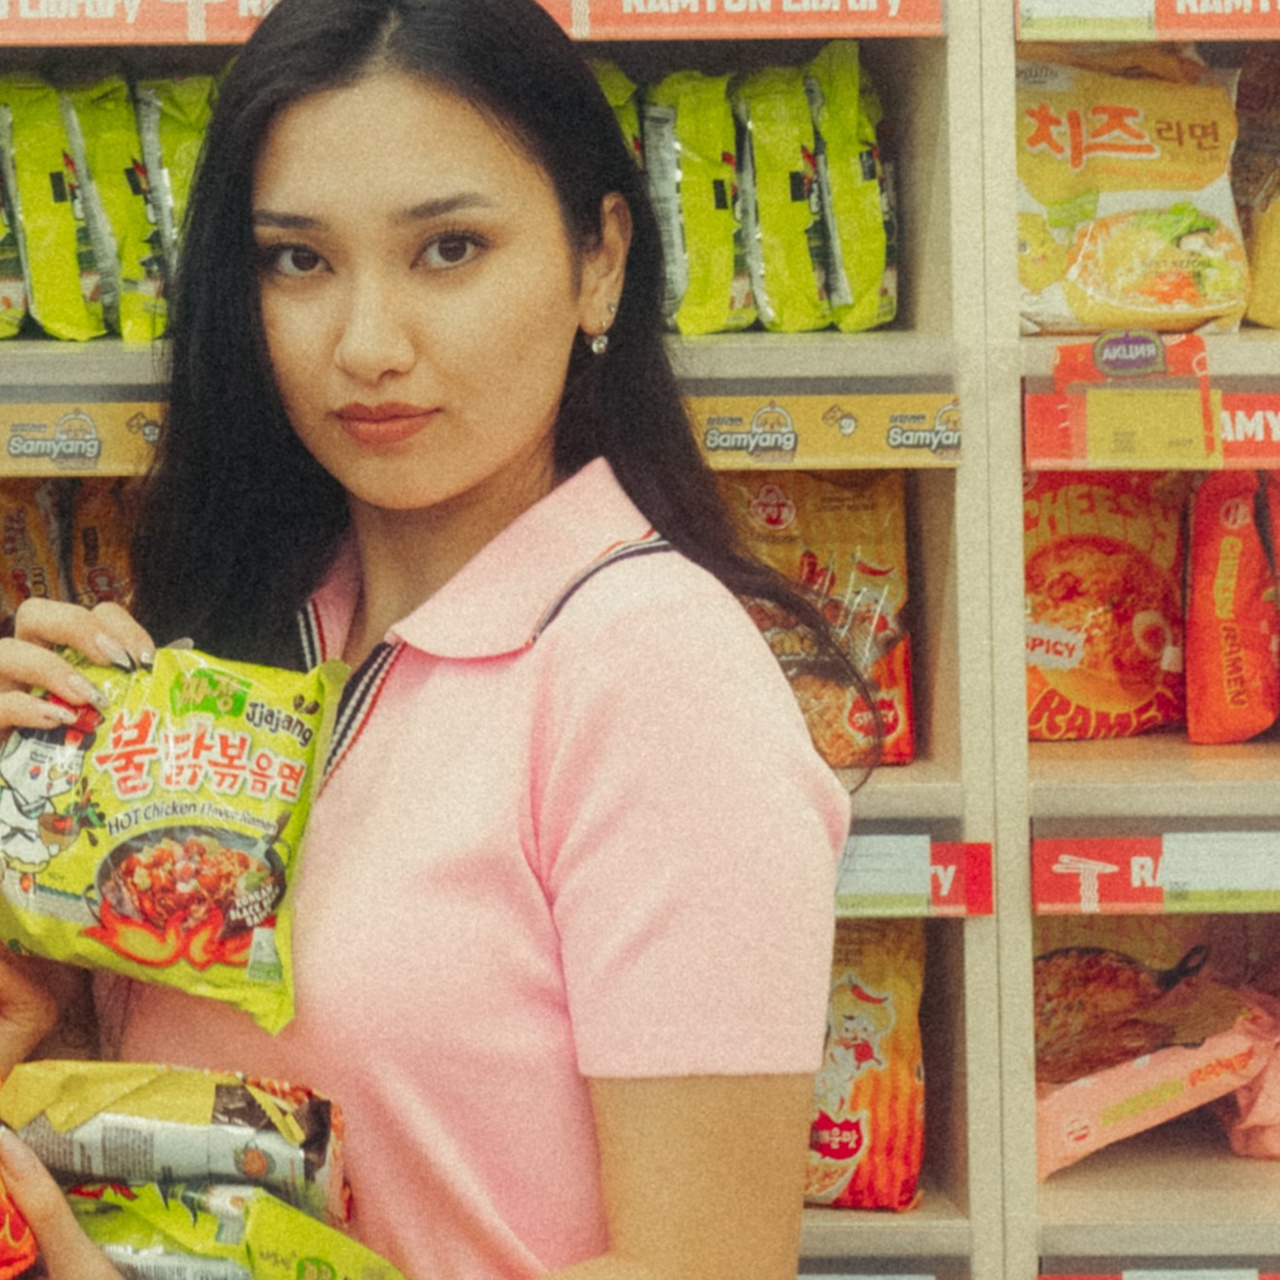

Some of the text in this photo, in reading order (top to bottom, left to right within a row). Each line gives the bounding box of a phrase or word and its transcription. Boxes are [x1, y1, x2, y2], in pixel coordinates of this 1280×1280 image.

[1025, 103, 1220, 169] 치즈 라면
[1101, 343, 1157, 361] АКЦИЯ
[8, 434, 99, 458] Samyang
[706, 428, 795, 451] Samyang
[246, 701, 315, 748] Jjajang
[95, 710, 308, 797] 불닭볶음면
[107, 808, 141, 835] HOT
[143, 800, 197, 821] Chicken
